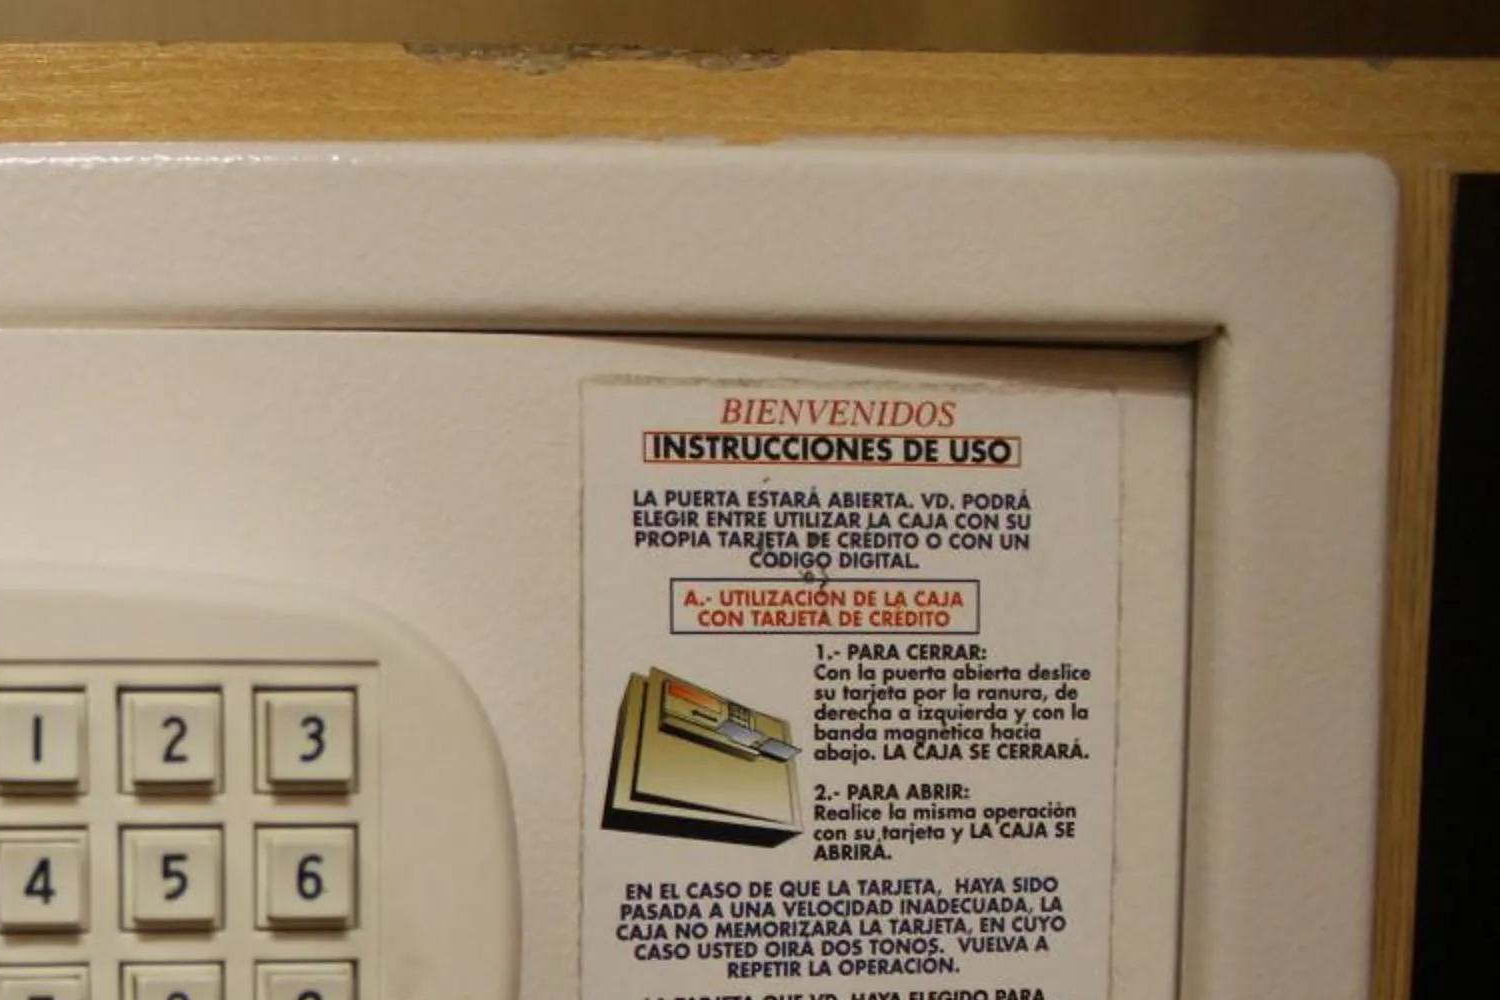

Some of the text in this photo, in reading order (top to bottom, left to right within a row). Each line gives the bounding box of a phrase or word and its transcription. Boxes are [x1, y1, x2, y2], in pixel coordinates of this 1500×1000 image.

[720, 398, 956, 428] BIENVENIDOS
[652, 435, 1012, 464] INSTRUCCIONES DE USO
[663, 491, 741, 509] PUERTA
[826, 492, 914, 510] ABIERTA.
[632, 511, 948, 530] ELEGIR ENTRE UTILIZAR CAJA
[634, 531, 711, 549] PROPIA
[717, 532, 800, 549] TARJETA
[838, 552, 919, 569] DIGITAL.
[912, 591, 964, 608] CAJA
[697, 611, 744, 627] CON
[750, 611, 832, 627] TARJETA
[846, 644, 901, 660] PARA
[905, 644, 987, 660] CERRAR:
[813, 664, 1090, 686] Con puerta abierta deslice
[841, 684, 906, 706] tarjeta
[813, 703, 1007, 726] derecha izquierda
[33, 716, 41, 762] 1
[163, 717, 188, 763] 2
[300, 716, 326, 762] 3
[813, 724, 1040, 741] banda hacia
[813, 745, 876, 767] abajo.
[912, 744, 963, 761] CAJA
[846, 784, 900, 800] PARA
[904, 784, 970, 800] ABRIR:
[813, 804, 882, 820] Realice
[912, 804, 976, 820] misma
[881, 822, 1048, 845] tarjeta CAJA
[24, 858, 55, 903] 4
[162, 855, 189, 899] 5
[297, 855, 323, 899] 6
[685, 877, 1058, 899] CASO QUE TARJETA, HAYA SIDO
[619, 897, 1033, 920] PASADA VELOCIDAD INADECUADA,
[615, 916, 1066, 941] CAJA TARJETA, CUYO
[633, 936, 1029, 960] CASO USTED TONOS. VUELVA
[726, 960, 801, 979] REPETIR
